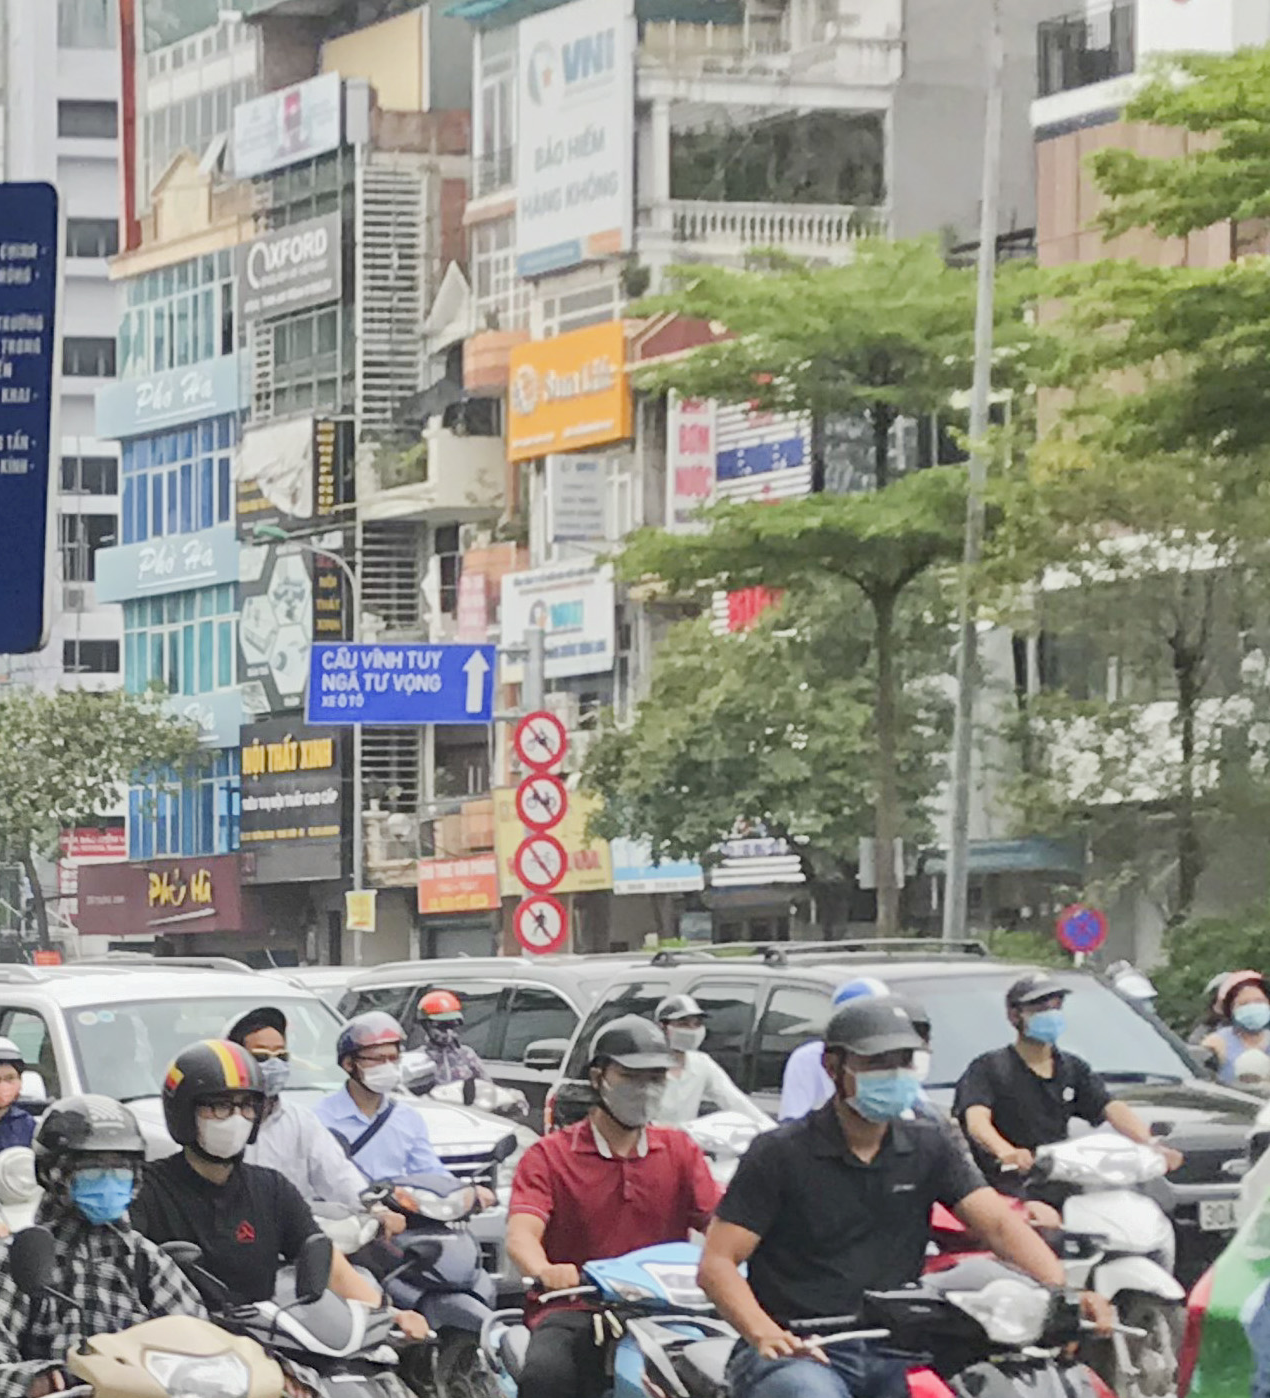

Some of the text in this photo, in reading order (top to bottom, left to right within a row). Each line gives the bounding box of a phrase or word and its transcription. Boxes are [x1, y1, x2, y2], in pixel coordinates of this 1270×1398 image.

[321, 647, 443, 669] CẦU VĨNH TUY
[321, 671, 442, 696] NGÃ TƯ VỌNG
